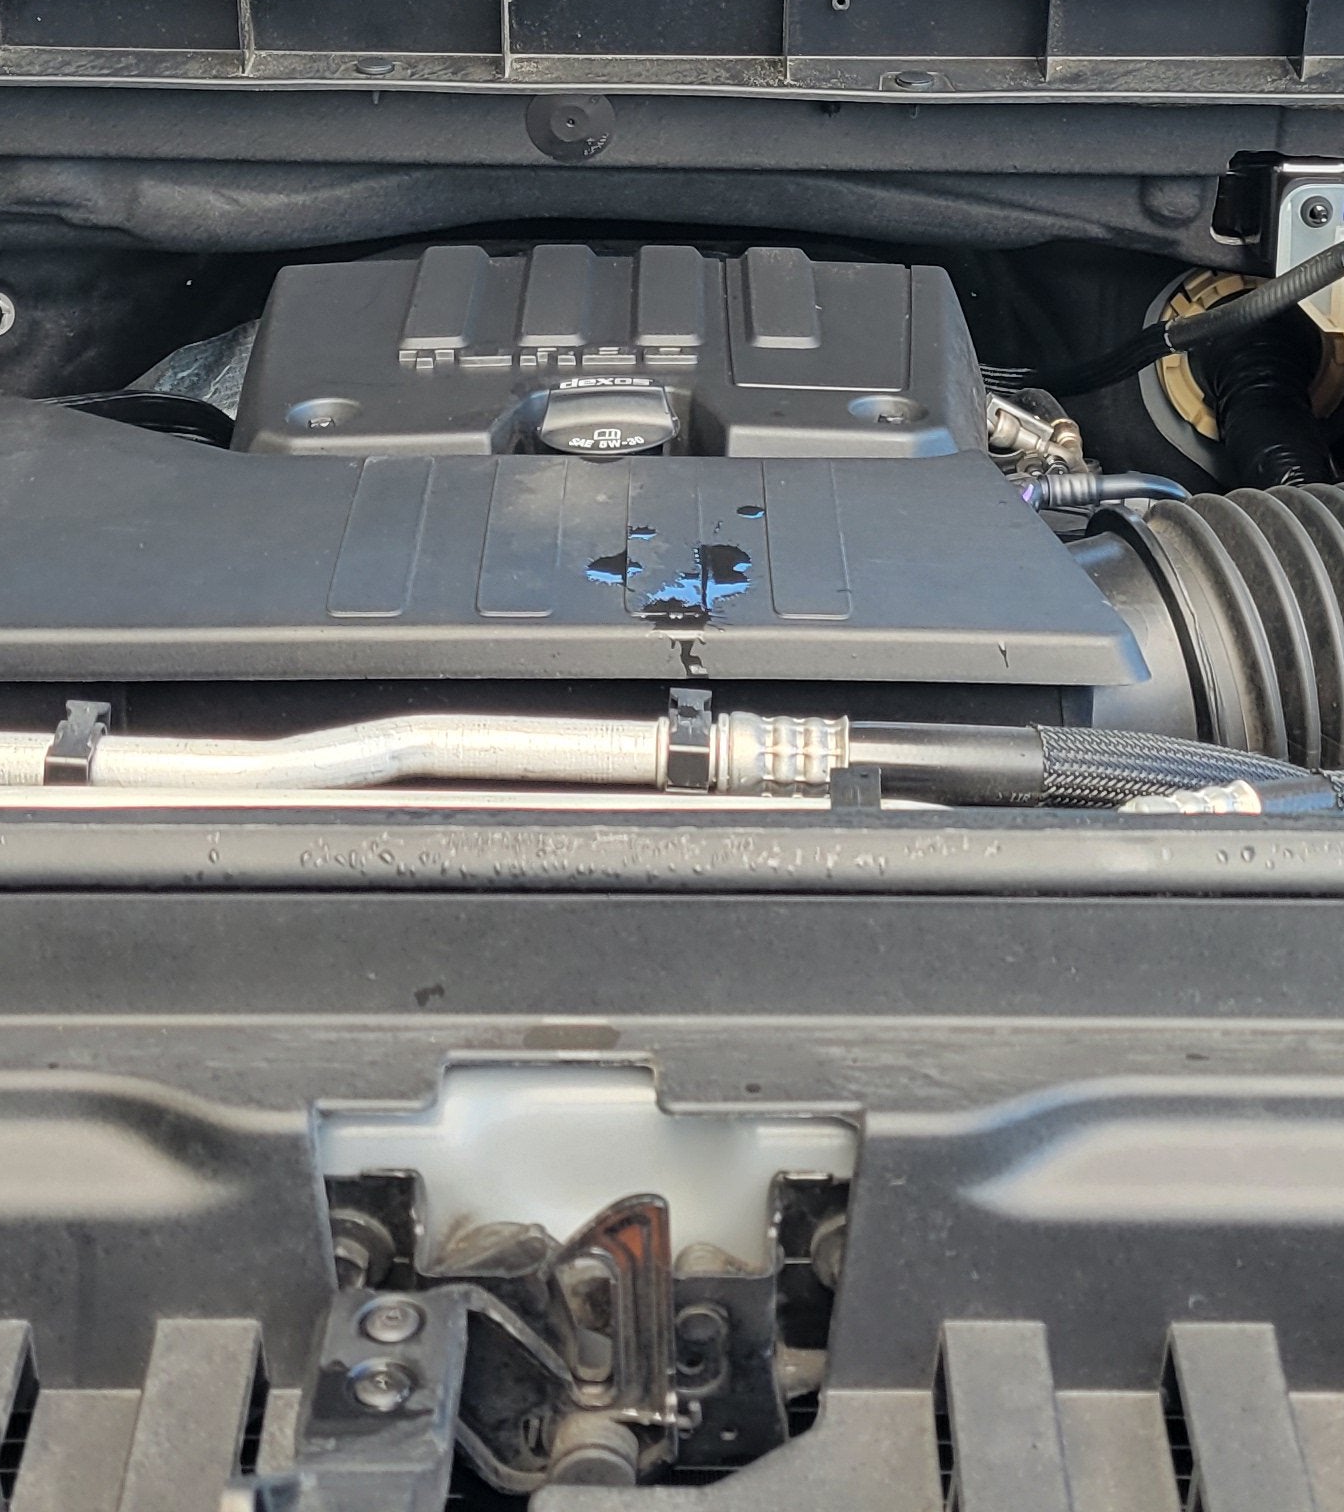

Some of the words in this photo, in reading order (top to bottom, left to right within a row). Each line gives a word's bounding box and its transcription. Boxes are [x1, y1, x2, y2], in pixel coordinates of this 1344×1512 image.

[559, 377, 655, 389] dexos
[568, 437, 595, 449] SAE
[598, 435, 645, 449] 5W-30
